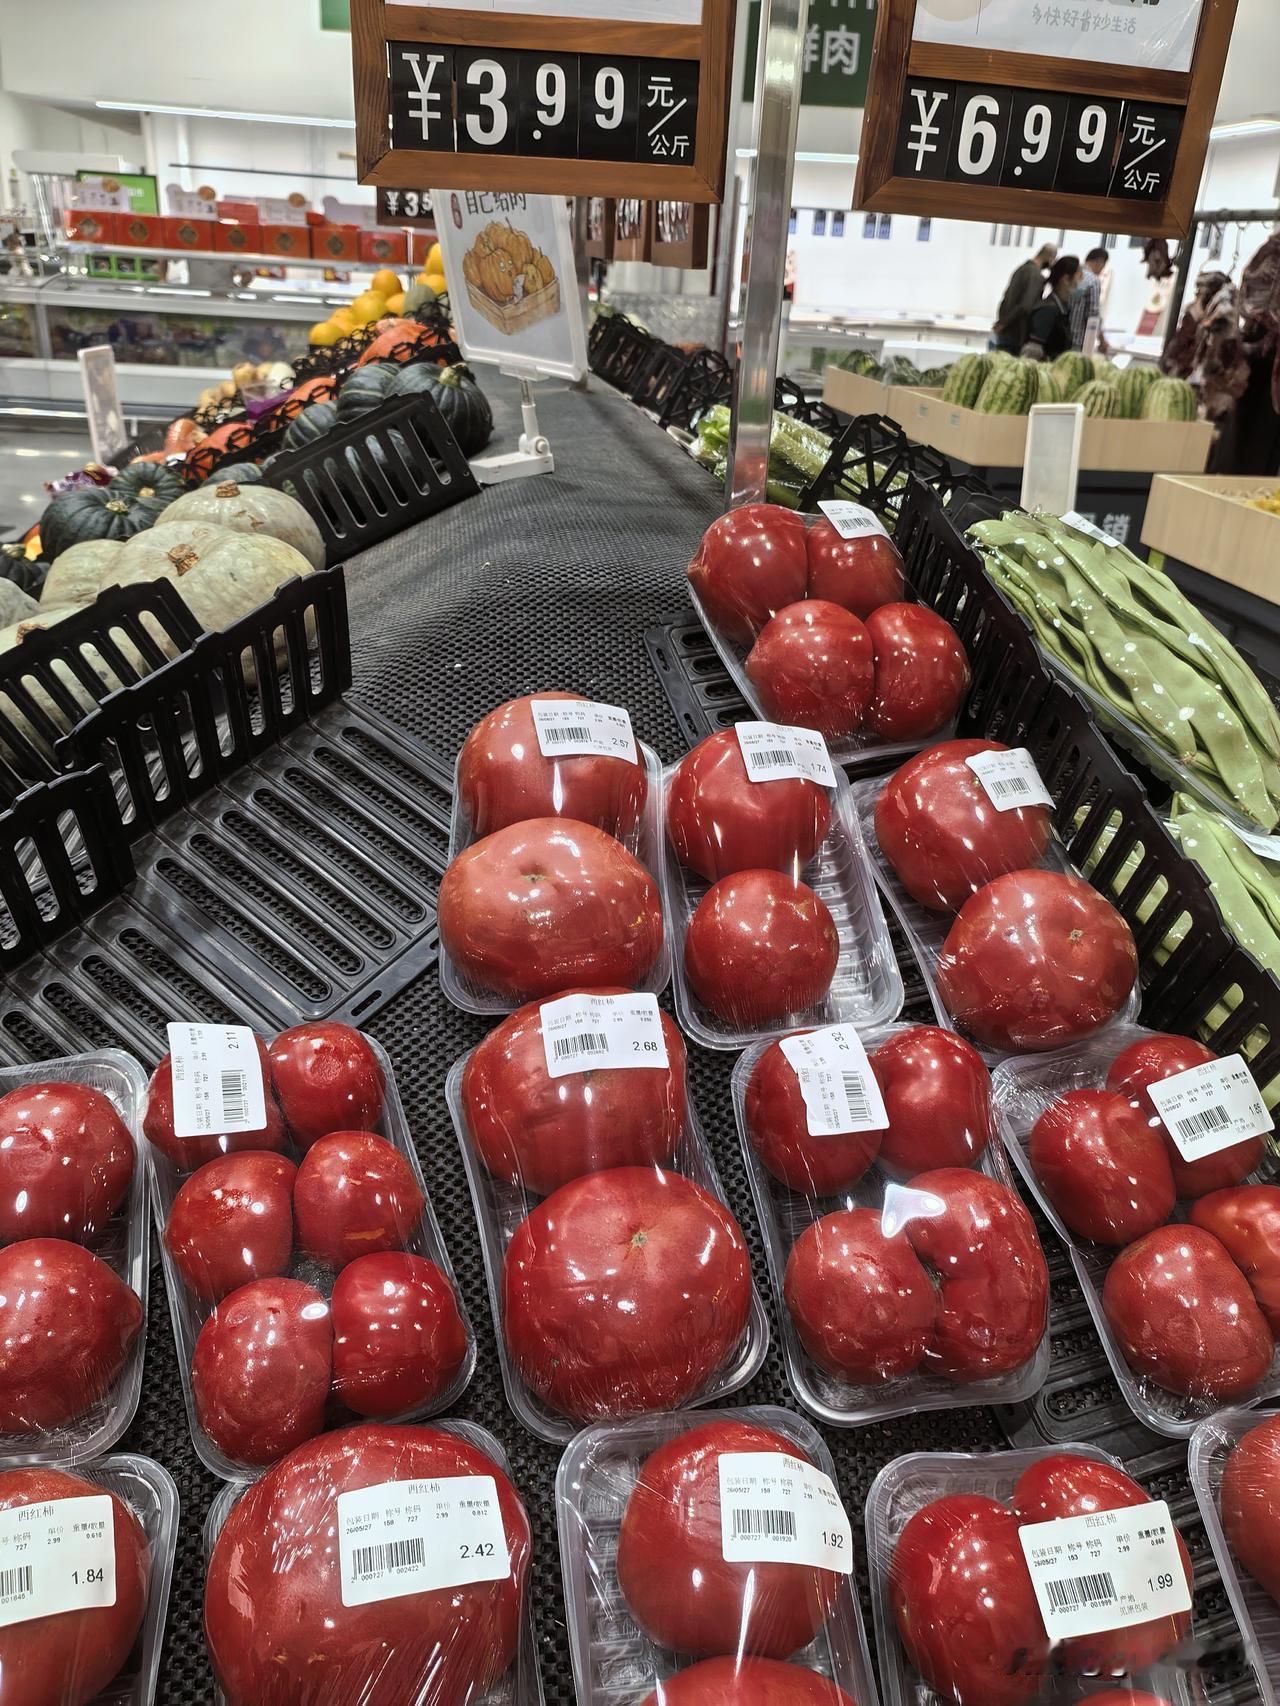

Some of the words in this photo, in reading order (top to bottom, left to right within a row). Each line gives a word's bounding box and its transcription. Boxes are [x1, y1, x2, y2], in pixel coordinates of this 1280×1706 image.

[226, 1031, 239, 1049] 2.11
[632, 1041, 658, 1051] 2.68
[832, 1031, 849, 1051] 2.32
[408, 1482, 441, 1494] 西红柿
[18, 1506, 54, 1521] 西红柿
[1085, 1513, 1117, 1528] 西红柿
[16, 1543, 27, 1551] 727
[821, 1531, 844, 1549] 1.92
[459, 1543, 495, 1559] 2.42
[1090, 1550, 1101, 1558] 727
[1117, 1545, 1130, 1553] 2.99
[71, 1568, 104, 1585] 1.84
[361, 1571, 384, 1582] 000727
[396, 1565, 419, 1575] 002422
[1147, 1573, 1173, 1592] 1.99
[1059, 1605, 1079, 1614] 000727
